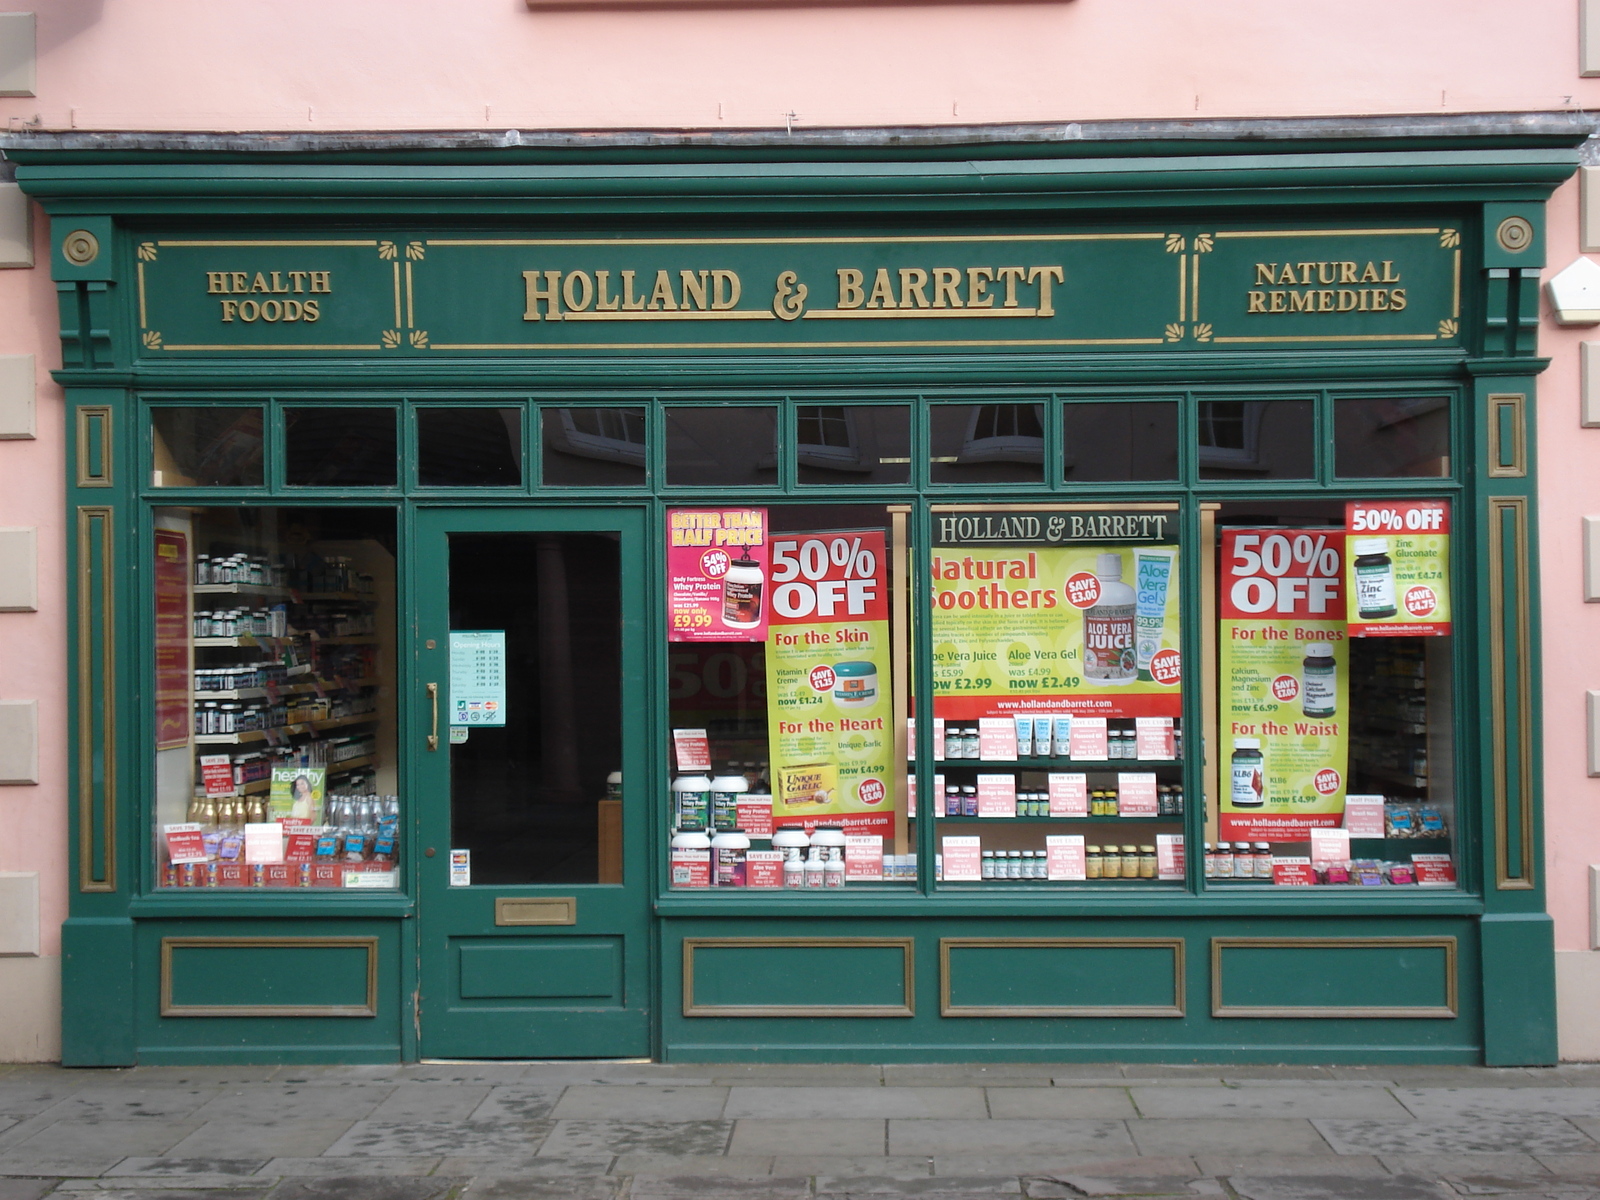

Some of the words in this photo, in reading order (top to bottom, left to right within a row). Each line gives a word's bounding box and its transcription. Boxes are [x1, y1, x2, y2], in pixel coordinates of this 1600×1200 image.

[1254, 260, 1400, 286] NATURAL
[206, 270, 332, 295] HEALTH
[522, 269, 742, 323] HOLLAND
[772, 270, 808, 322] &
[836, 265, 1065, 318] BARRETT
[1246, 287, 1407, 314] REMEDIES
[220, 299, 321, 323] FOODS
[671, 512, 721, 529] BETTER
[723, 512, 763, 529] THAN
[1352, 509, 1403, 531] 50%
[1405, 508, 1444, 530] OFF
[939, 516, 1041, 543] HOLLAND
[1046, 516, 1066, 542] &
[1070, 514, 1168, 541] BARRETT
[672, 529, 713, 546] HALF
[716, 528, 763, 546] PRICE
[1395, 540, 1413, 548] Zinc
[1231, 534, 1340, 577] 50%
[1395, 549, 1438, 557] Gluconate
[703, 552, 727, 568] 54%
[772, 537, 876, 583] 50%
[709, 562, 726, 576] OFF
[1138, 564, 1169, 578] Aloe
[1418, 571, 1443, 580] £4.74
[673, 583, 693, 591] Whey
[695, 582, 721, 590] Protein
[1068, 578, 1097, 593] SAVE
[1138, 578, 1167, 591] Vera
[1361, 584, 1382, 593] Zinc
[772, 579, 877, 618] OFF
[1071, 589, 1098, 604] £3.00
[1137, 590, 1158, 604] Gel
[1230, 576, 1340, 613] OFF
[1407, 589, 1432, 601] SAVE
[691, 607, 707, 615] only
[1408, 599, 1435, 611] £4.75
[673, 615, 713, 628] £9.99
[1137, 616, 1163, 628] 99.9%
[1088, 622, 1108, 635] ALOE
[1111, 622, 1132, 635] VERA
[1231, 627, 1256, 640] For
[1262, 626, 1288, 640] the
[1294, 627, 1344, 641] Bones
[775, 633, 799, 646] For
[804, 630, 830, 645] the
[836, 628, 869, 643] Skin
[1088, 634, 1132, 649] JUICE
[453, 641, 480, 649] Opening
[933, 652, 944, 661] oe
[947, 651, 970, 661] Vera
[973, 650, 997, 662] Juice
[1008, 649, 1031, 660] Aloe
[1034, 650, 1057, 660] Vera
[1060, 648, 1077, 660] Gel
[1153, 654, 1181, 670] SAVE
[776, 668, 803, 676] Vitamin
[811, 669, 833, 681] SAVE
[941, 669, 963, 677] £5.99
[1028, 668, 1051, 676] £4.99
[1231, 668, 1260, 676] Calcium,
[814, 678, 833, 688] £1.25
[954, 678, 992, 689] £2.99
[1009, 679, 1038, 689] now
[1041, 676, 1080, 689] £2.49
[1274, 679, 1296, 690] SAVE
[1277, 688, 1296, 698] £7.00
[778, 698, 797, 706] now
[798, 696, 823, 705] £1.24
[997, 699, 1112, 709] www.hollandandbarrett.com
[1253, 704, 1279, 712] £6.99
[779, 721, 803, 734] For
[808, 718, 834, 732] the
[840, 717, 884, 731] Heart
[1231, 722, 1256, 735] For
[1262, 721, 1288, 735] the
[1293, 721, 1339, 736] Waist
[838, 742, 862, 750] Unique
[863, 740, 882, 748] Garlic
[839, 767, 858, 775] now
[861, 765, 885, 774] £4.99
[1233, 770, 1252, 778] KLB6
[272, 767, 323, 786] healthy
[786, 773, 822, 785] UNIQUE
[1316, 773, 1337, 784] SAVE
[786, 782, 823, 793] GARLIC
[861, 782, 881, 794] SAVE
[1318, 781, 1338, 792] £5.00
[863, 791, 883, 802] £5.00
[1292, 796, 1317, 804] £4.99
[283, 818, 303, 826] healthy
[1230, 818, 1335, 827] www.hollandandbarrett.com
[223, 870, 240, 879] tea
[269, 869, 287, 879] tea
[316, 869, 333, 879] tea
